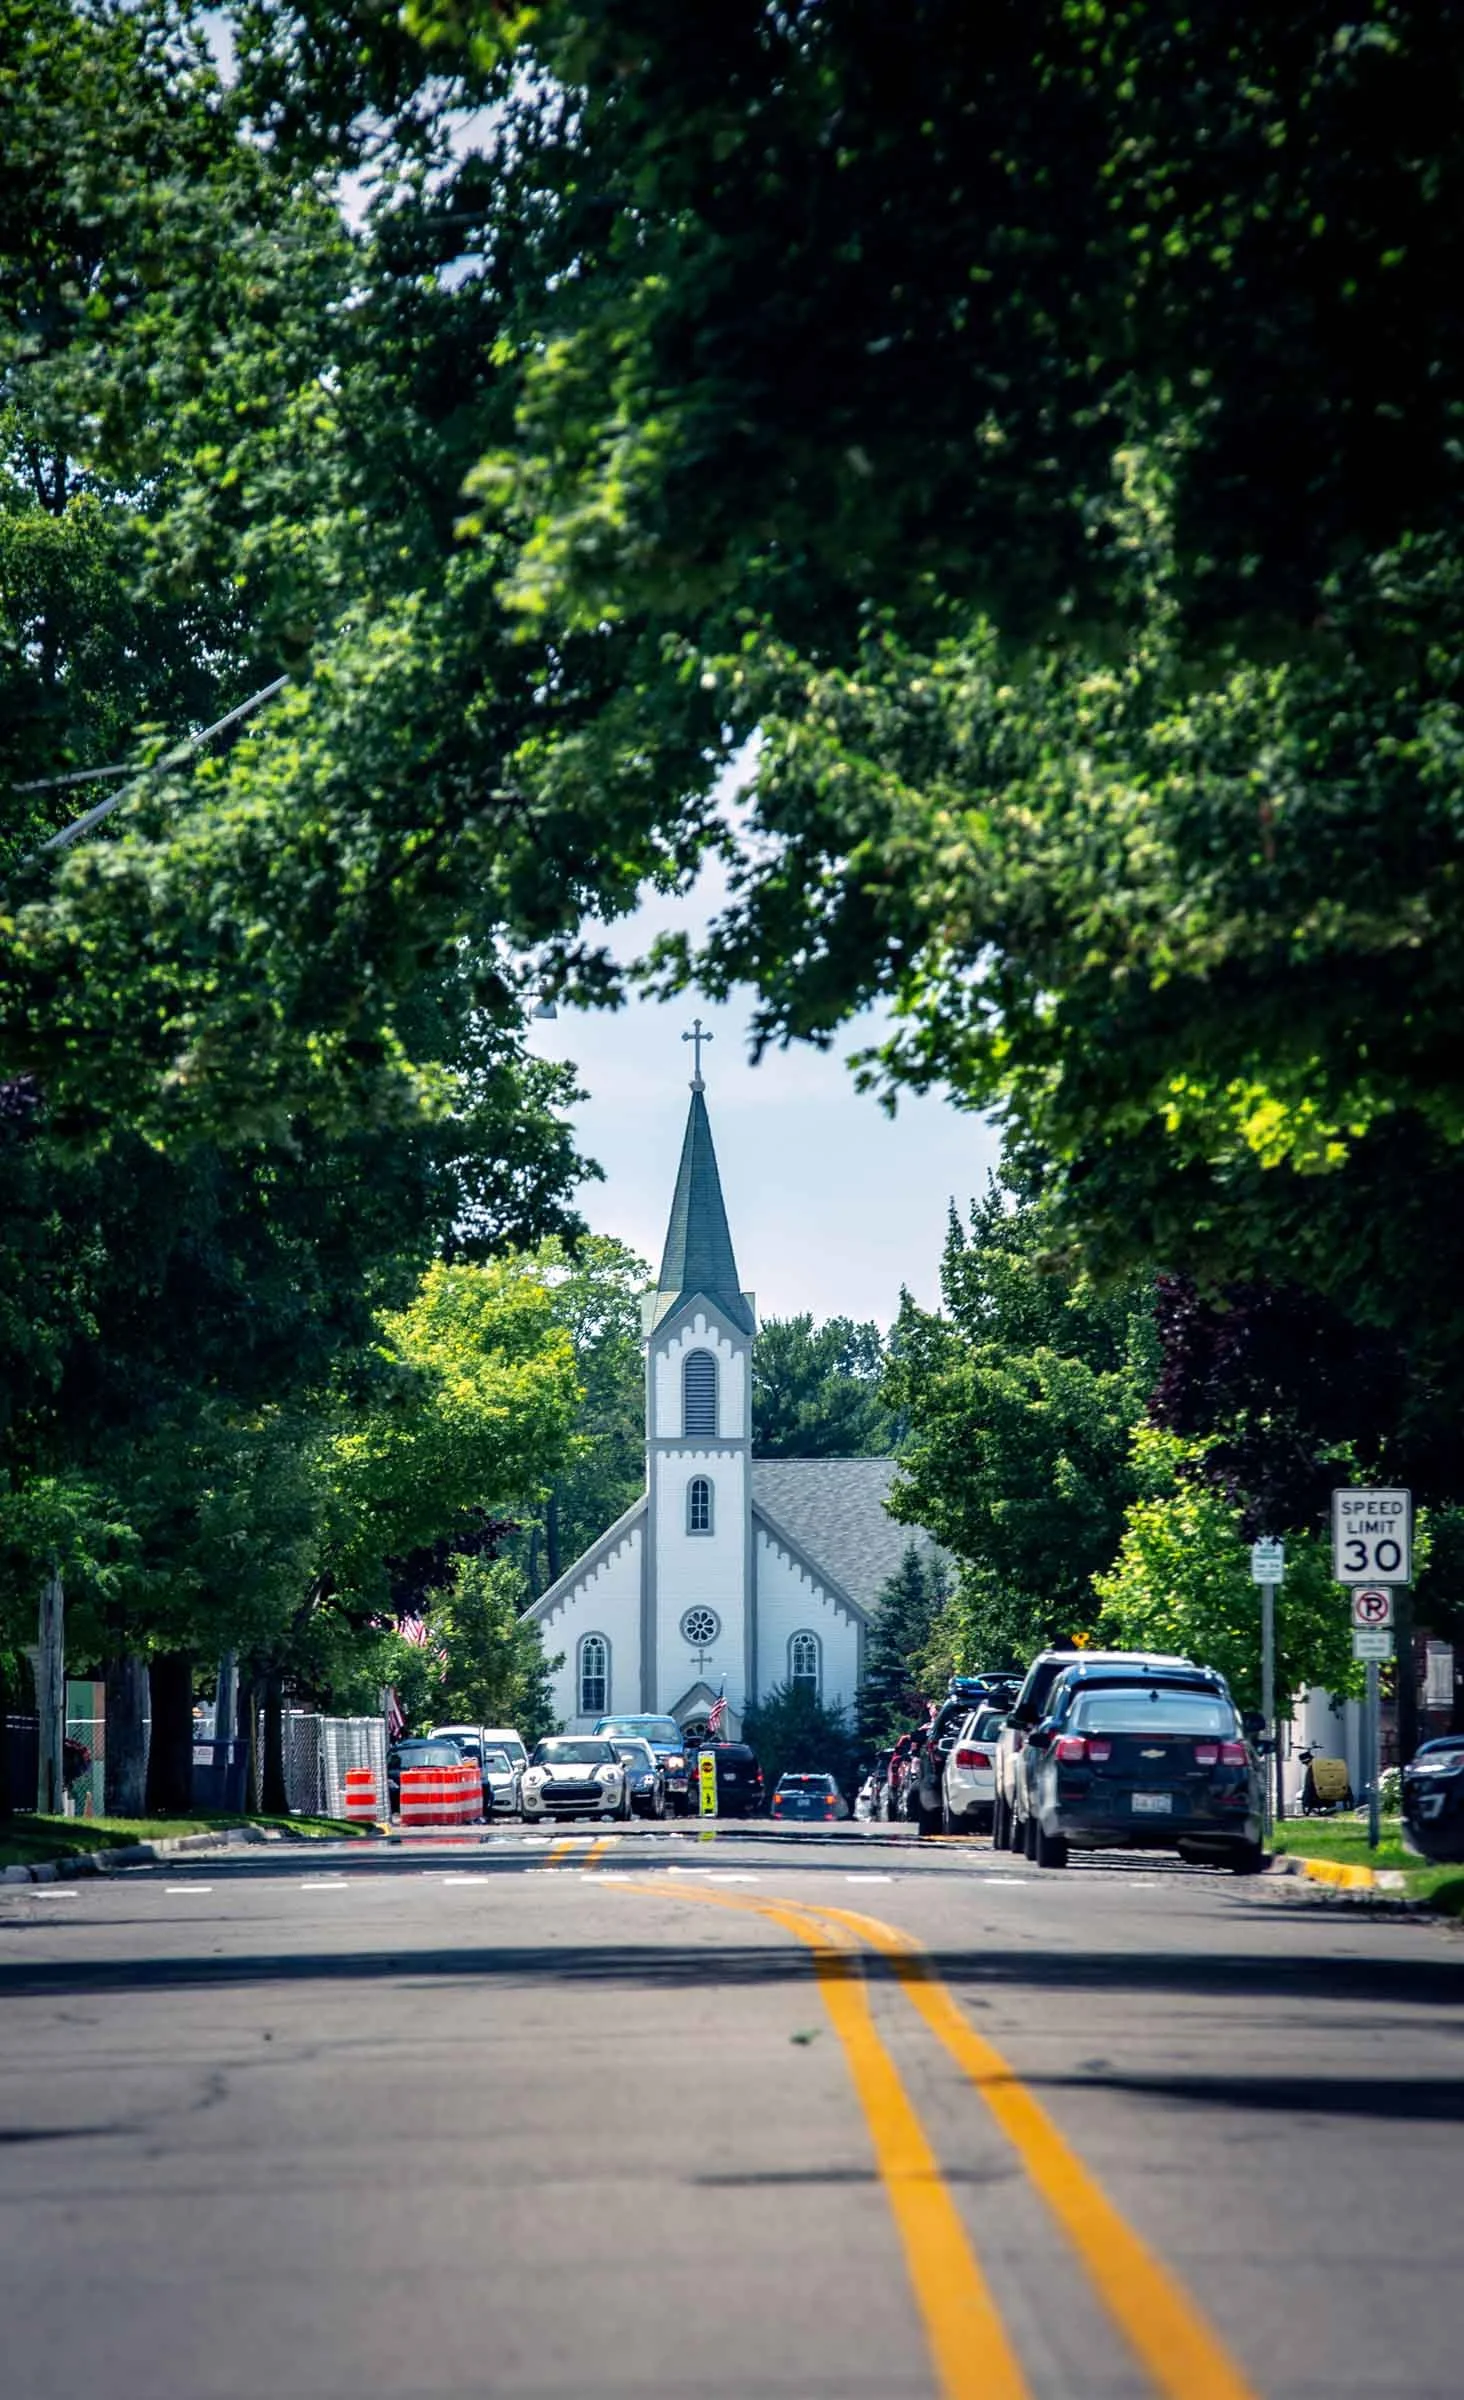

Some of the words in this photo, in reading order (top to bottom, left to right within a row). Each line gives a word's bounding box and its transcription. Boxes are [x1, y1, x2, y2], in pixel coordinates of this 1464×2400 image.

[1342, 1501, 1403, 1515] SPEED
[1347, 1521, 1395, 1534] LIMIT
[1344, 1540, 1401, 1571] 30
